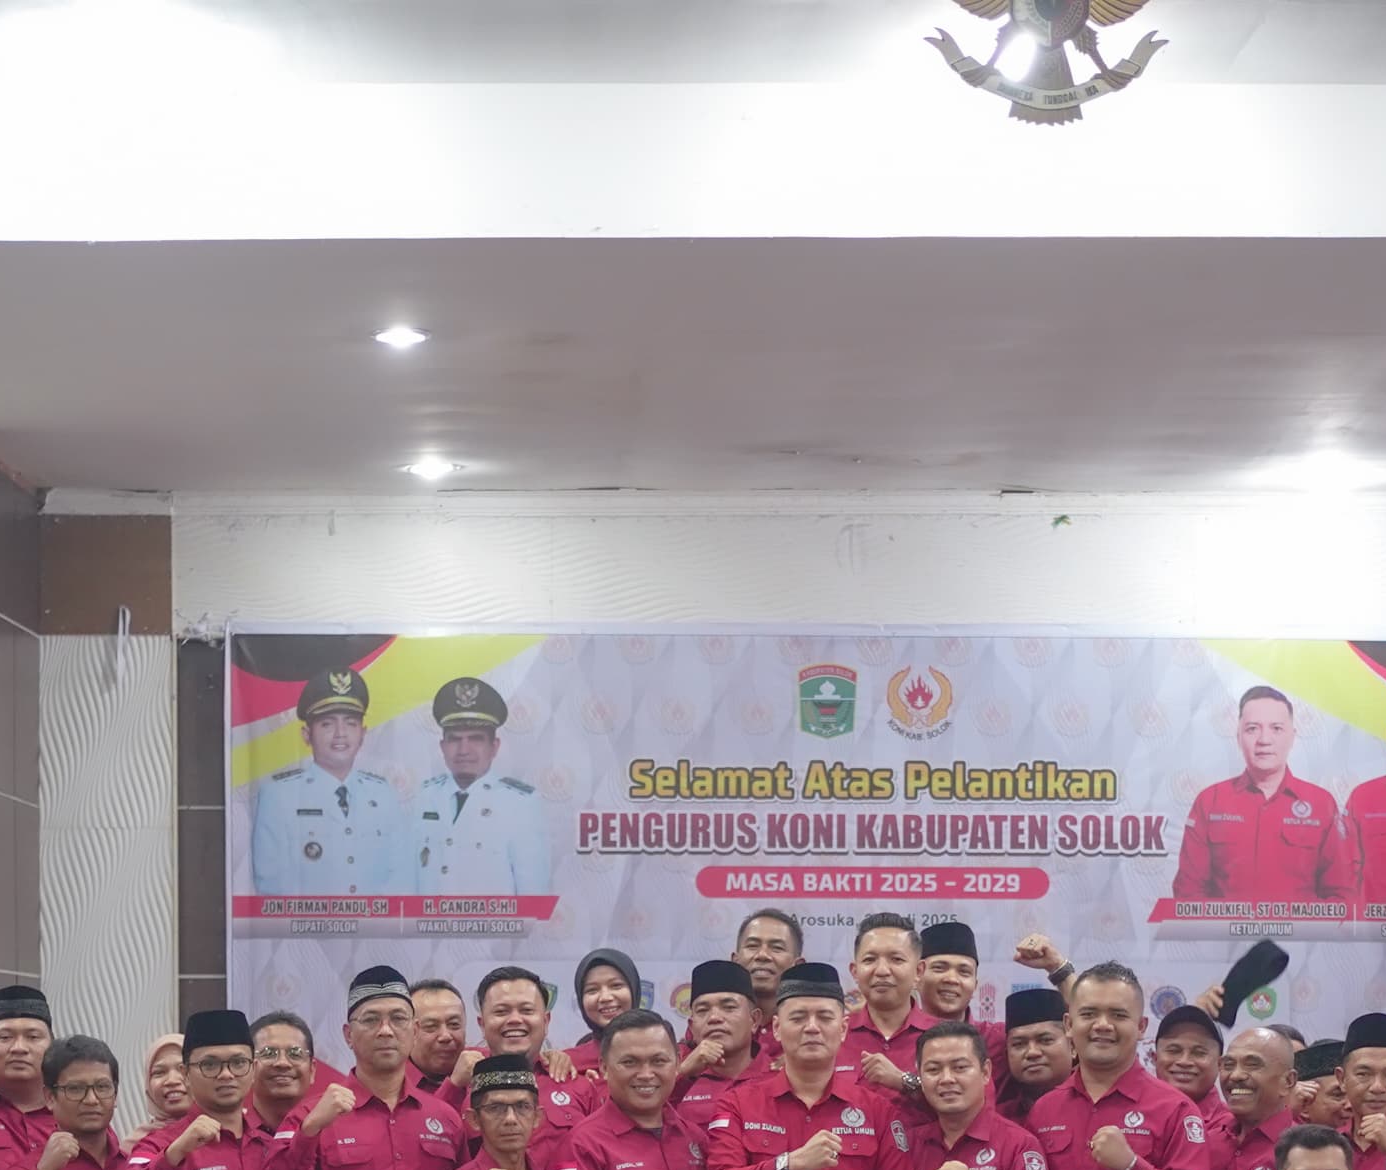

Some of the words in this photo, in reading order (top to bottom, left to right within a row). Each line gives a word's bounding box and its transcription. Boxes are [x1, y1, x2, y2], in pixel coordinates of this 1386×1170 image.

[629, 758, 795, 800] Selamat
[802, 759, 895, 800] Atas
[904, 760, 1118, 801] Pelantikan
[578, 812, 758, 850] PENGURUS
[766, 812, 847, 850] KONI
[856, 813, 1049, 851] KABUPATEN
[1057, 814, 1166, 852] SOLOK
[725, 873, 795, 892] MASA
[803, 873, 873, 892] BAKTI
[880, 874, 938, 893] 2025
[963, 874, 1021, 893] 2029
[263, 900, 284, 914] JON
[286, 900, 329, 914] FIRMAN
[331, 900, 371, 917] PANDU,
[372, 900, 388, 914] SH
[424, 900, 436, 913] H.
[1176, 903, 1202, 916] DONI
[1257, 903, 1271, 916] ST
[1291, 904, 1347, 917] MAJOLELO
[292, 920, 325, 933] BUPATI
[327, 920, 357, 933] SOLOK
[417, 920, 450, 933] WAKIL
[452, 920, 488, 933] BUPATI
[490, 920, 523, 933] SOLOK
[1229, 922, 1261, 935] KETUA
[1263, 922, 1294, 935] UMUM
[744, 1121, 761, 1131] DONI
